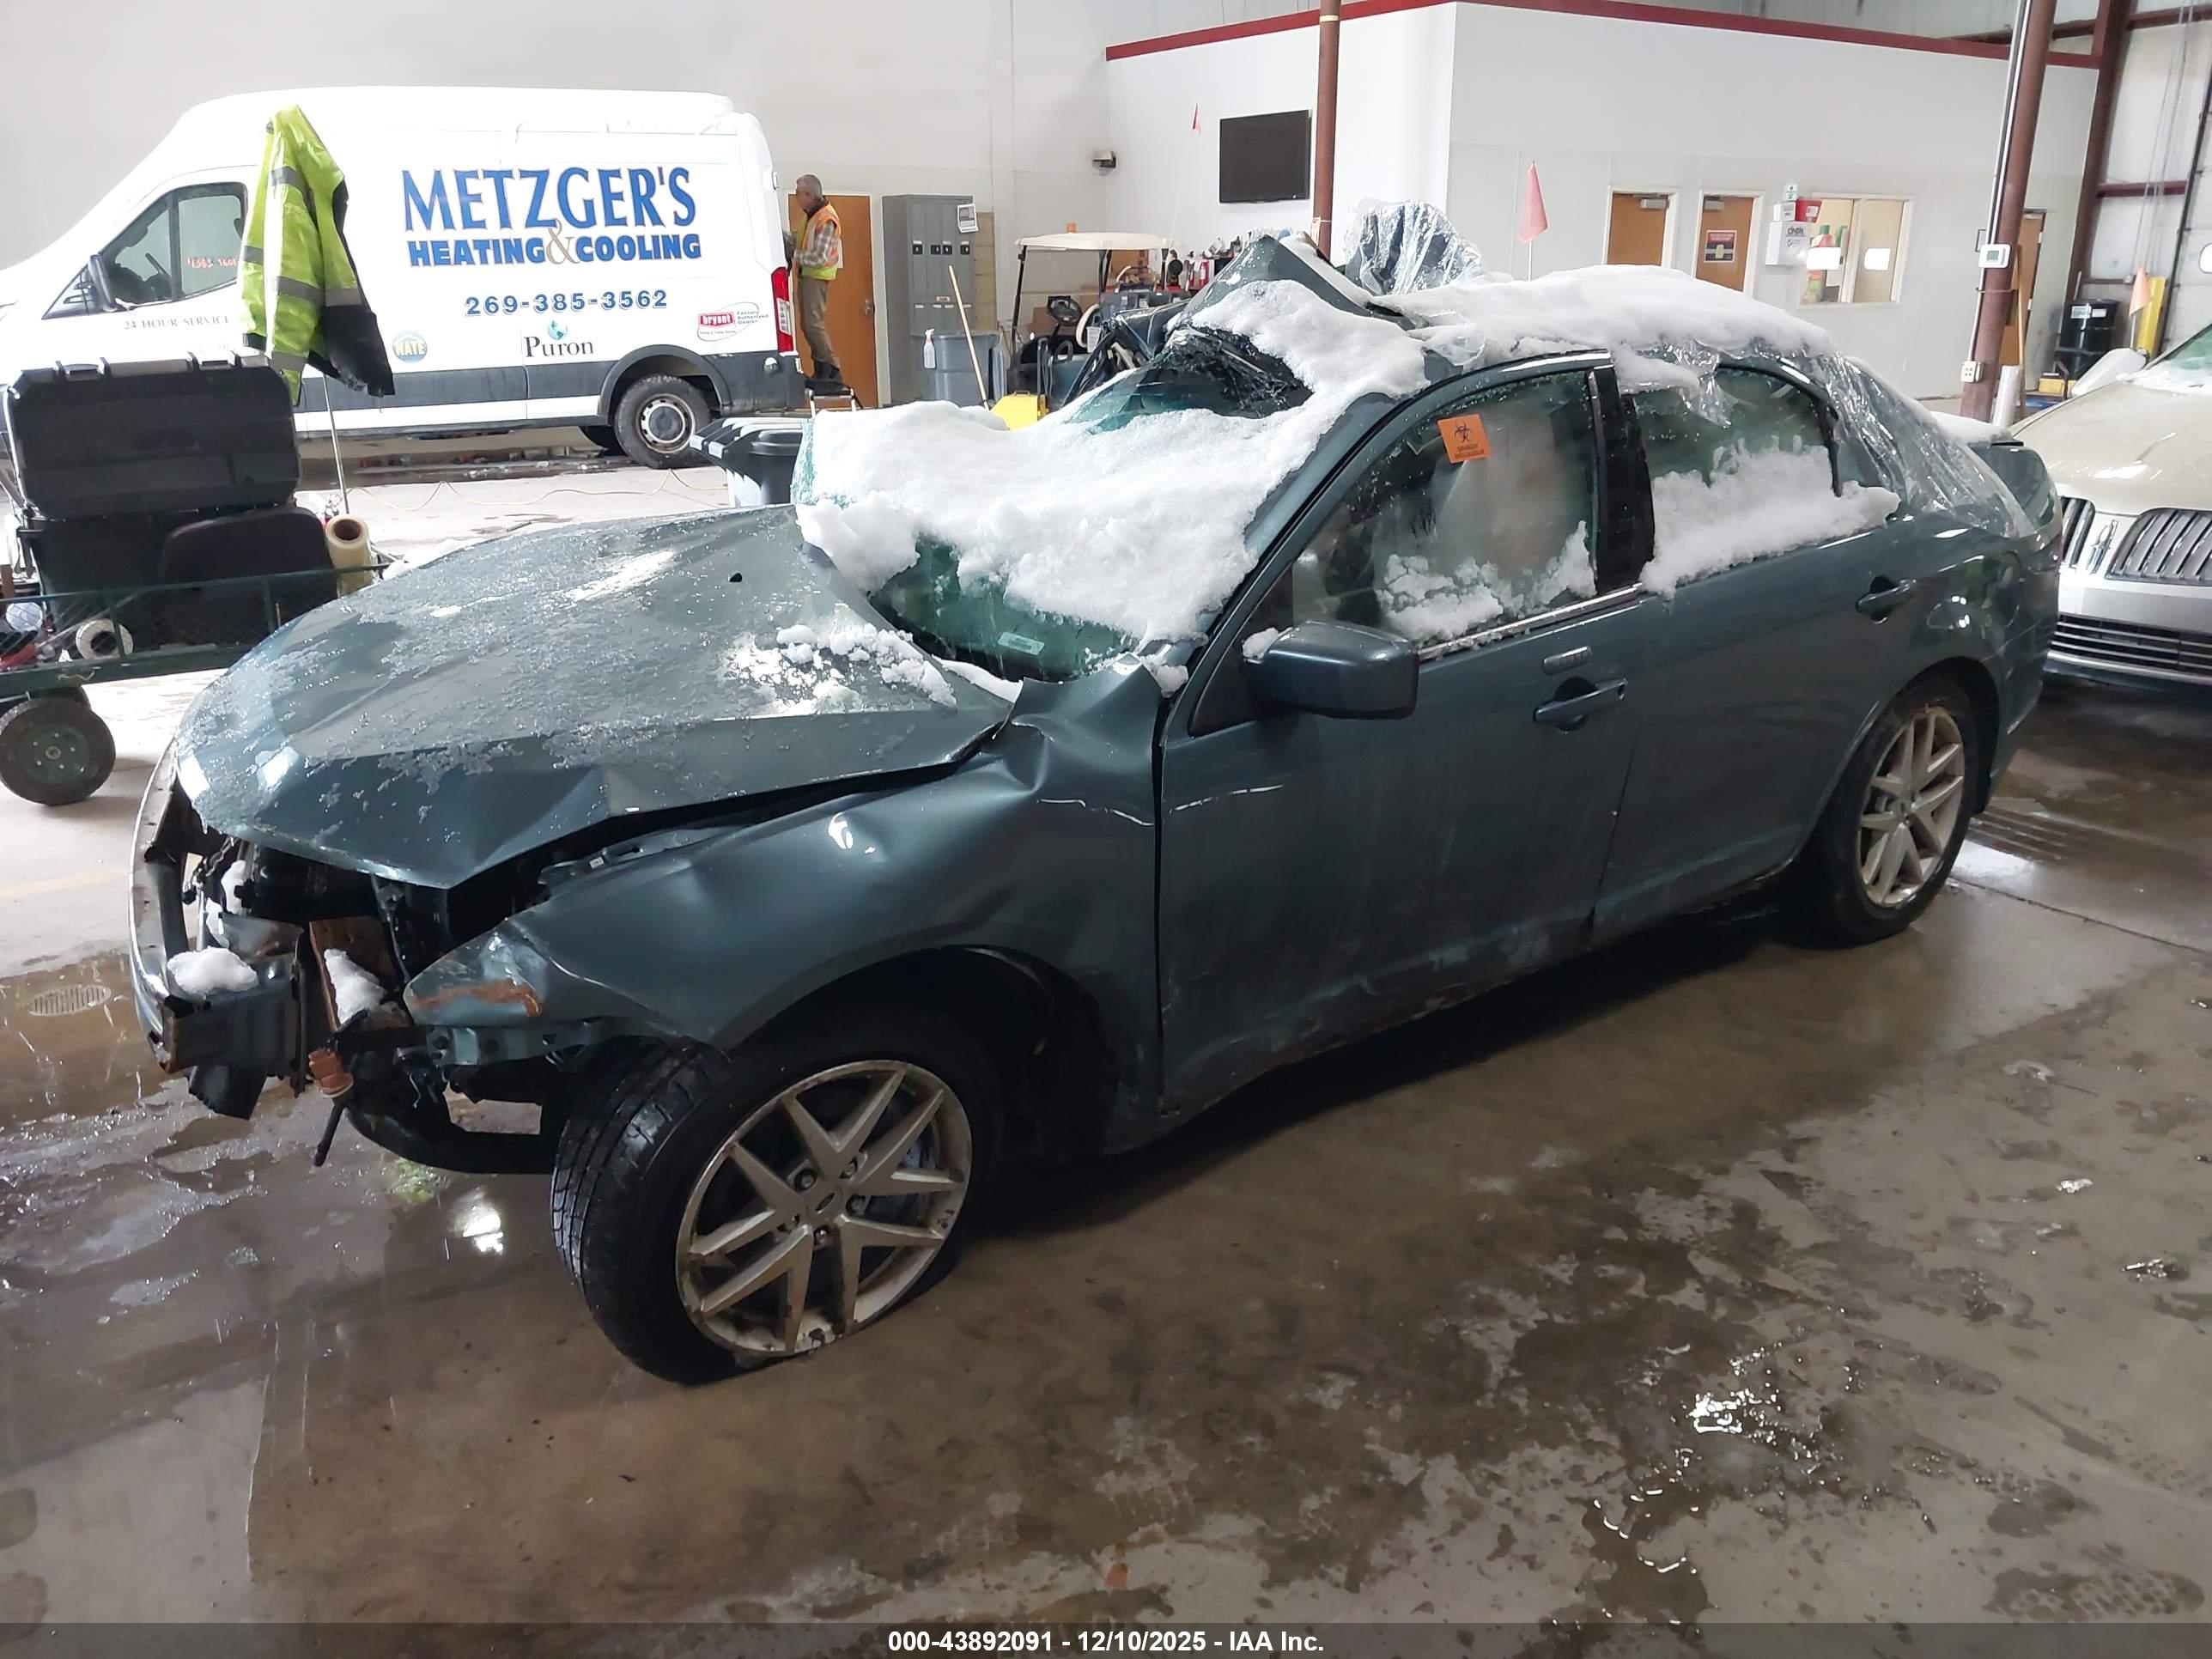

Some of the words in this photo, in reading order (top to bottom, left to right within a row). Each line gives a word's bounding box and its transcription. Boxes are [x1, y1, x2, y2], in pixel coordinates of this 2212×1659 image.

[402, 167, 696, 231] METZGER'S
[407, 237, 545, 266] HEATING
[546, 218, 580, 264] &
[575, 234, 702, 262] COOLING
[465, 289, 667, 316] 269-385-3562
[125, 320, 137, 330] 24
[143, 319, 178, 328] HOUR
[183, 315, 229, 326] SERVICE
[702, 315, 731, 325] bryant
[394, 343, 425, 356] NATE
[524, 336, 594, 357] Puron
